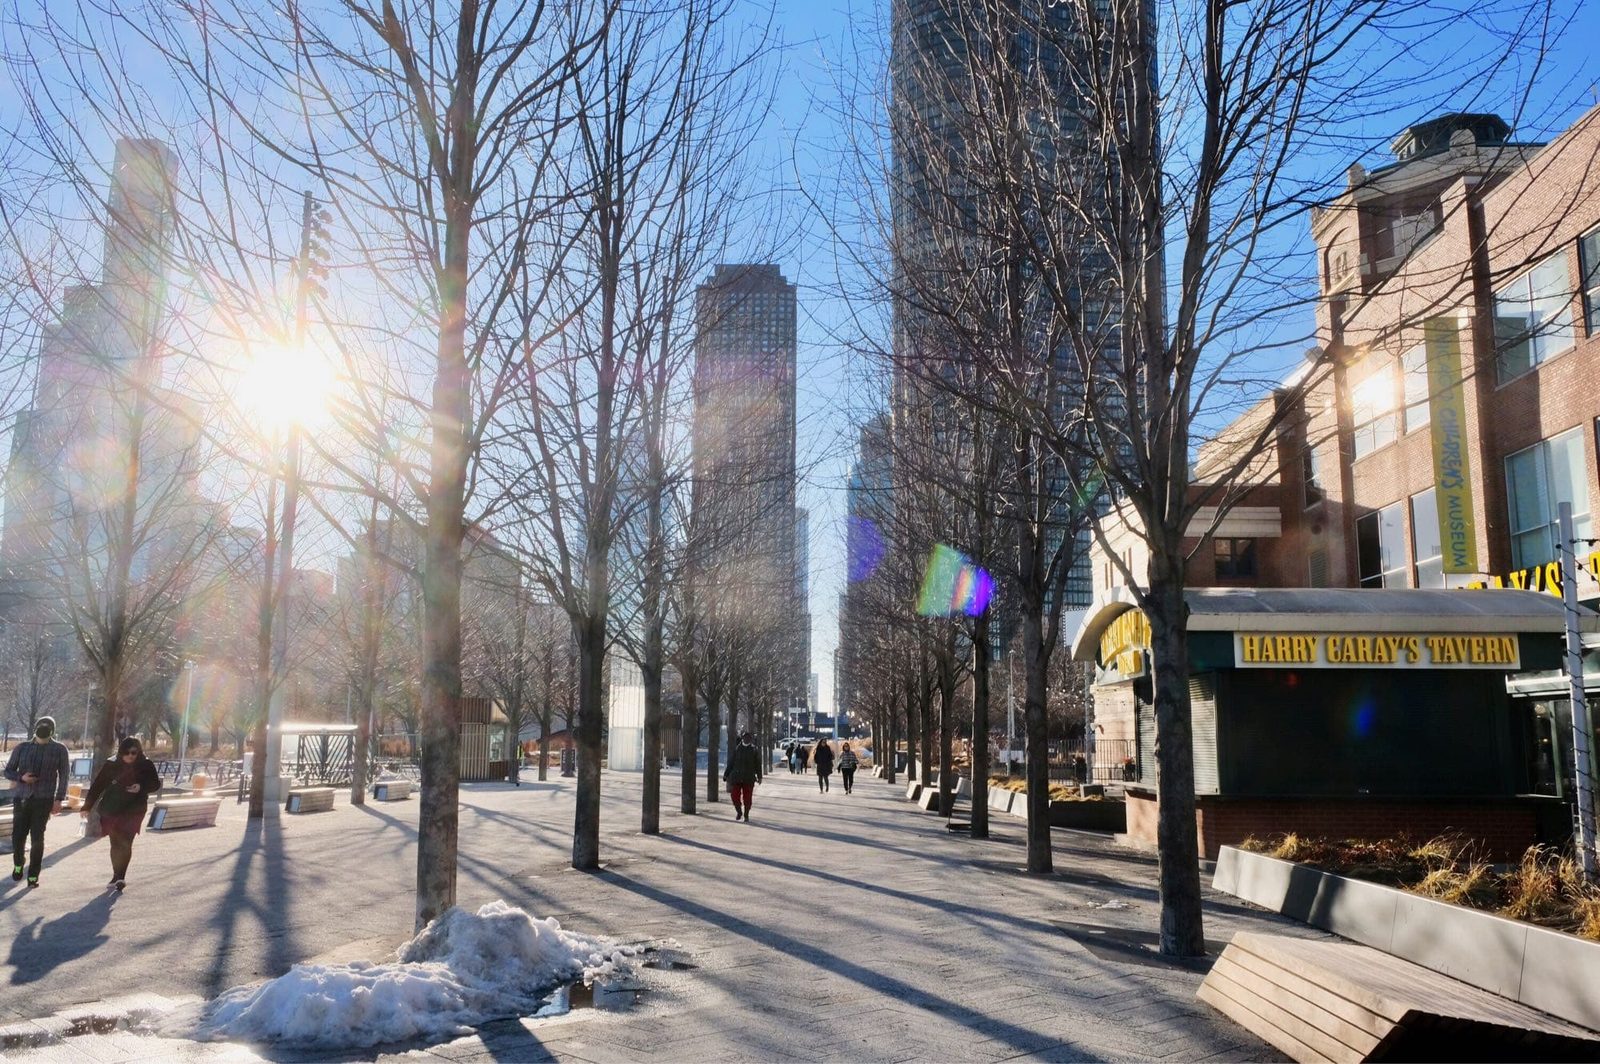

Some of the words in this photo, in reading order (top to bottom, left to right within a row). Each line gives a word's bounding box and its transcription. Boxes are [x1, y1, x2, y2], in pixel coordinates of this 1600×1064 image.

[1448, 494, 1468, 568] MUSEUM
[1242, 635, 1319, 663] HARRY
[1325, 634, 1420, 664] CARAY'S
[1427, 635, 1517, 664] TAVERN
